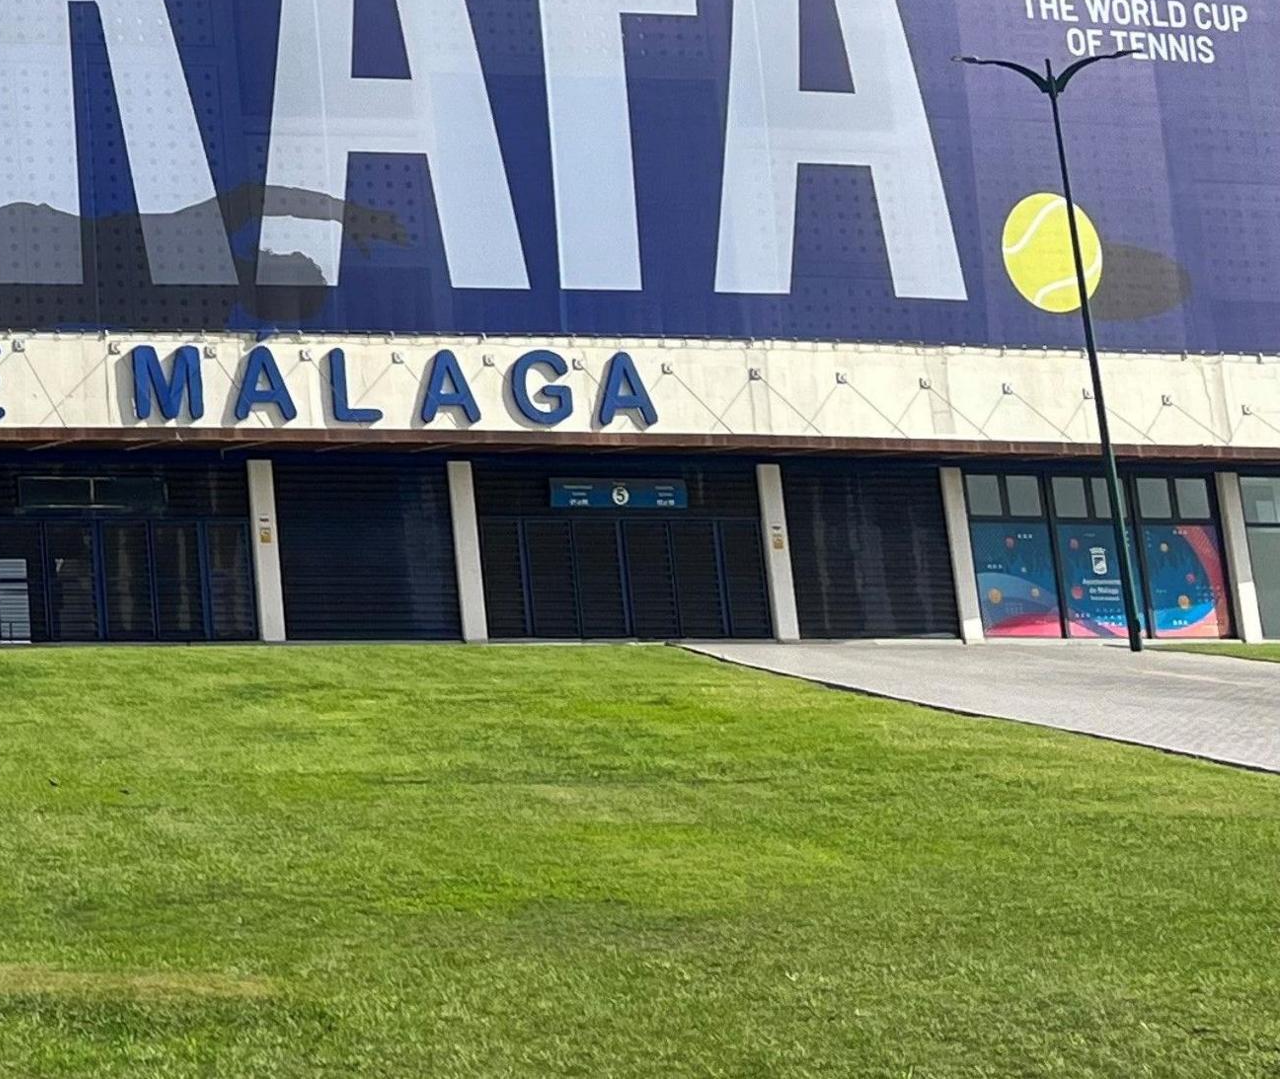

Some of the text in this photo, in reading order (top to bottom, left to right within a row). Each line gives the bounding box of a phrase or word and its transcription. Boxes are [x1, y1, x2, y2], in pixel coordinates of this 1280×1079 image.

[1192, 1, 1249, 33] CUP
[1066, 27, 1215, 64] OF TENNIS
